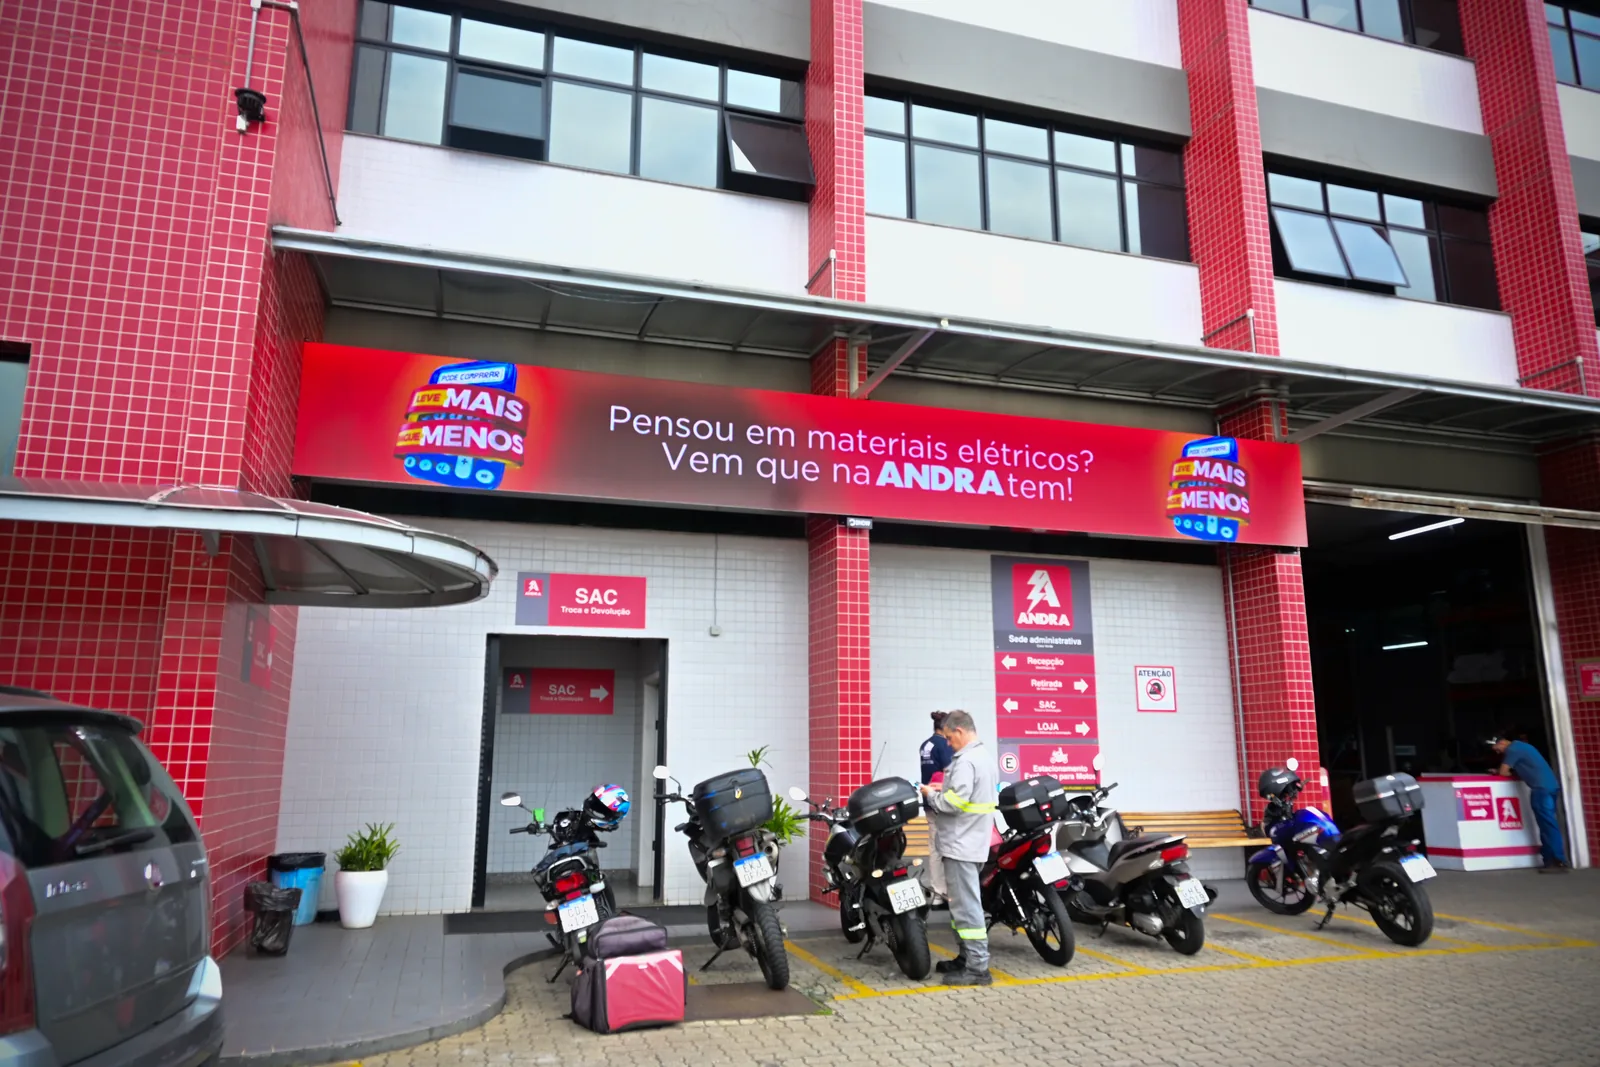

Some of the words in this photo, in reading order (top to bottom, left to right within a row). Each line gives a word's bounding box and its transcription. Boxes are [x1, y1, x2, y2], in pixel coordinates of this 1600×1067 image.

[441, 373, 458, 382] PODE
[459, 370, 500, 381] COMPARAR
[416, 393, 442, 403] LEVE
[443, 388, 523, 422] MAIS
[420, 425, 524, 455] MENOS
[609, 405, 734, 442] Pensou
[746, 424, 795, 447] em
[808, 429, 948, 460] materiais
[958, 439, 1094, 473] elétricos?
[662, 442, 743, 476] Vem
[756, 456, 820, 484] que
[833, 462, 870, 485] na
[875, 460, 1004, 497] ANDRA
[1008, 473, 1073, 502] tem!
[1193, 460, 1246, 487] MAIS
[1181, 491, 1250, 514] MENOS
[575, 587, 618, 605] SAC
[560, 605, 583, 614] Troca
[590, 606, 631, 617] Devolução
[1017, 612, 1071, 627] ANDRA
[1008, 634, 1028, 643] Sede
[1029, 636, 1082, 646] administrativa
[1027, 656, 1064, 667] Recepção
[1138, 668, 1172, 678] ATENÇÃO
[1031, 678, 1063, 688] Retirada
[548, 684, 576, 695] SAC
[1039, 700, 1056, 709] SAC
[1037, 722, 1059, 731] LOJA
[1006, 757, 1014, 768] E
